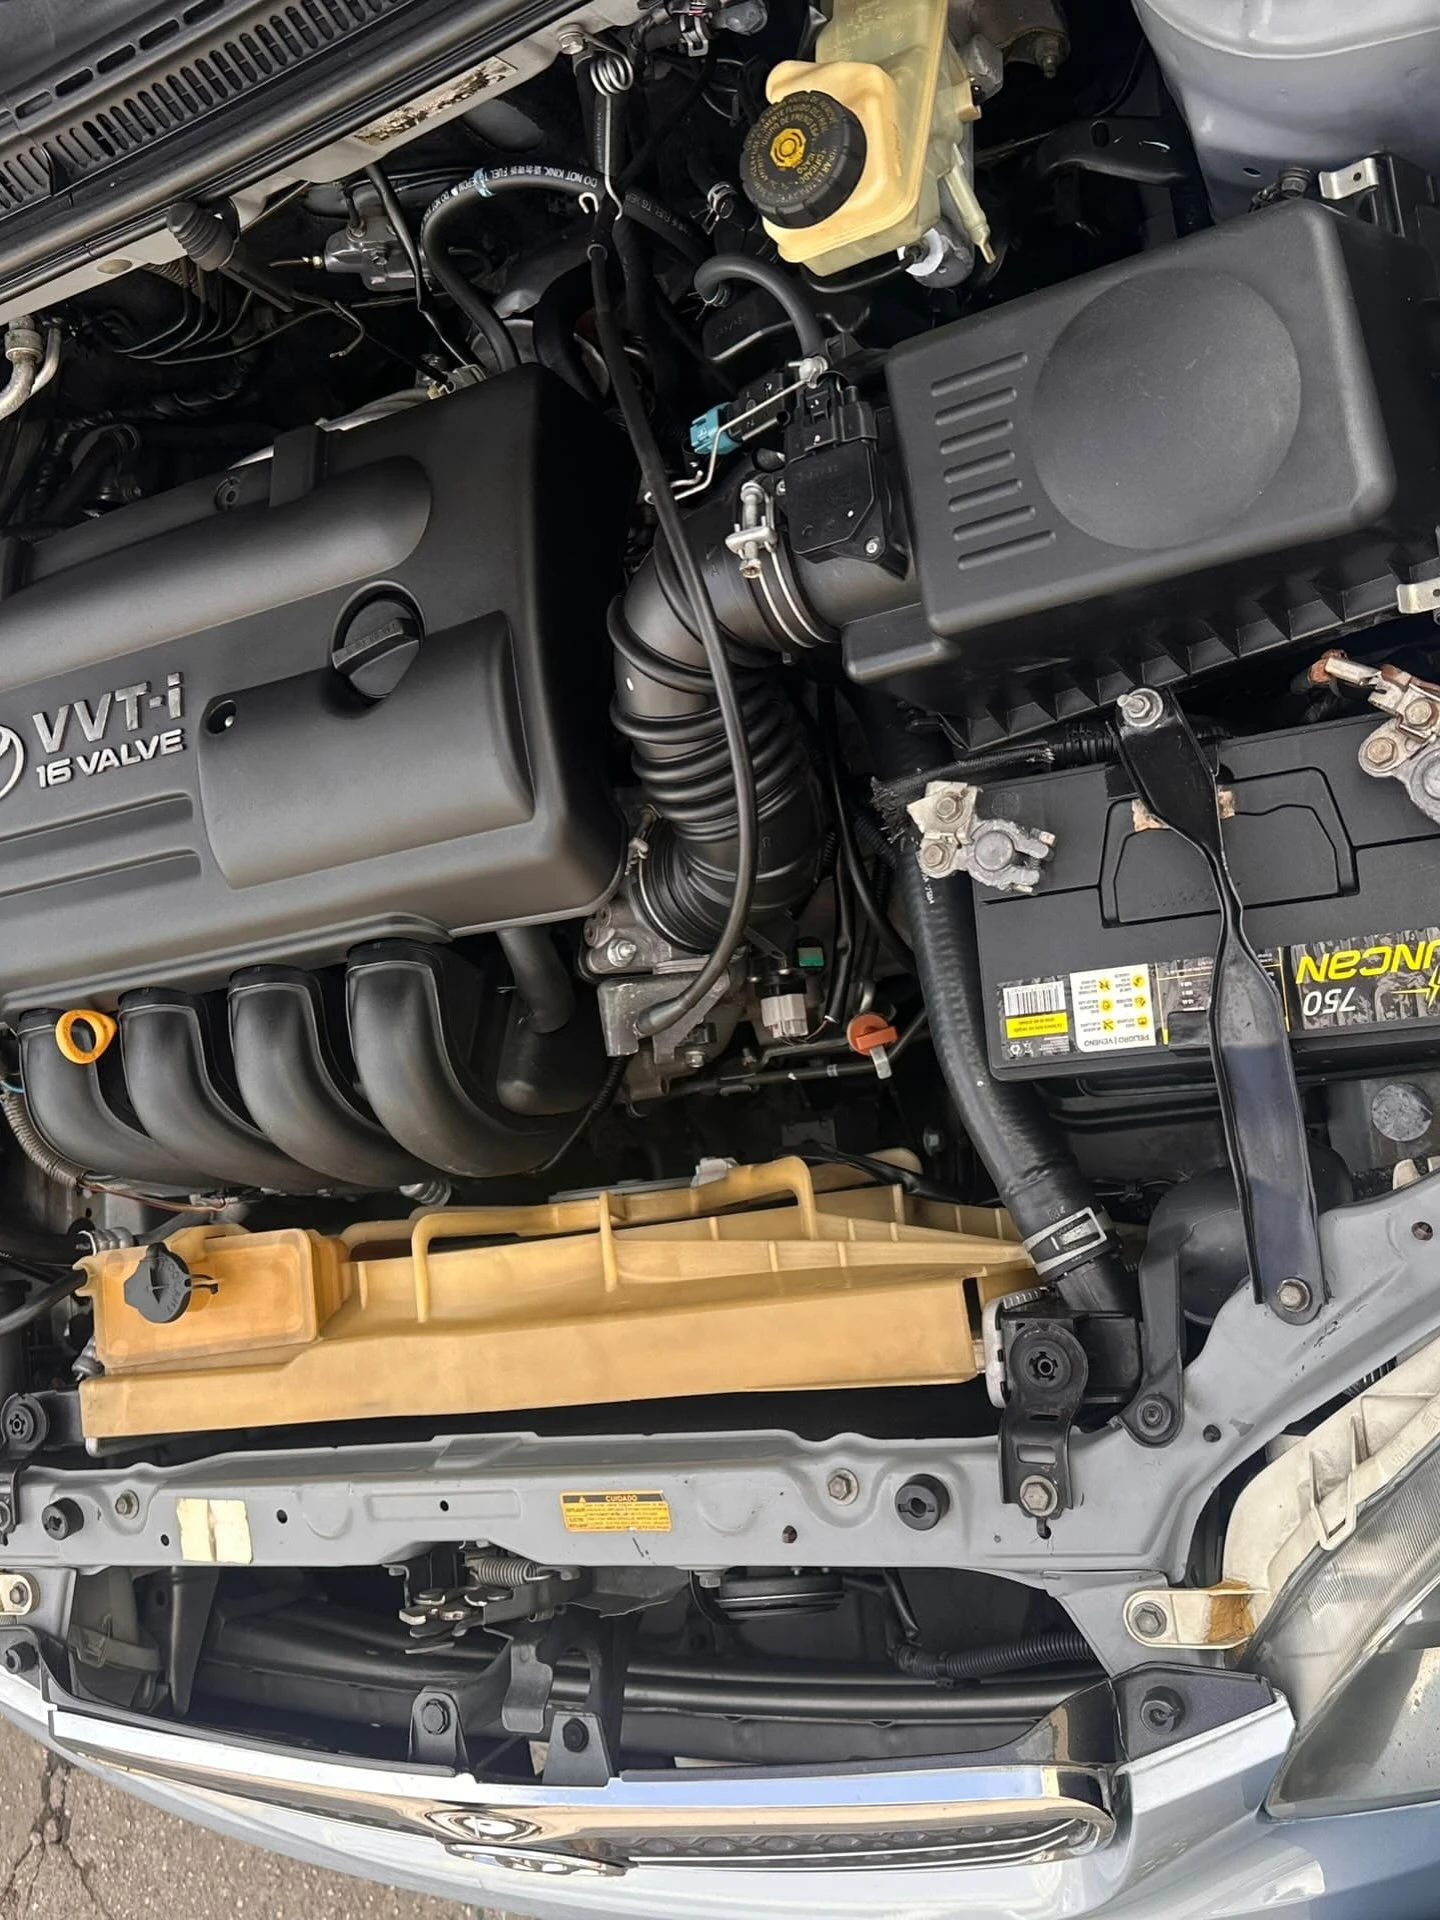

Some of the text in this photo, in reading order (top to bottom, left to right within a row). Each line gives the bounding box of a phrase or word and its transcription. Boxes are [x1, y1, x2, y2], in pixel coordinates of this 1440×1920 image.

[491, 165, 508, 178] FUEL
[565, 172, 583, 184] NOT
[584, 175, 598, 188] DO
[32, 671, 183, 754] VVT-i
[36, 729, 185, 789] 16 VALVE
[1303, 987, 1356, 1016] 750
[1084, 1034, 1149, 1047] PELIGRO VENENO
